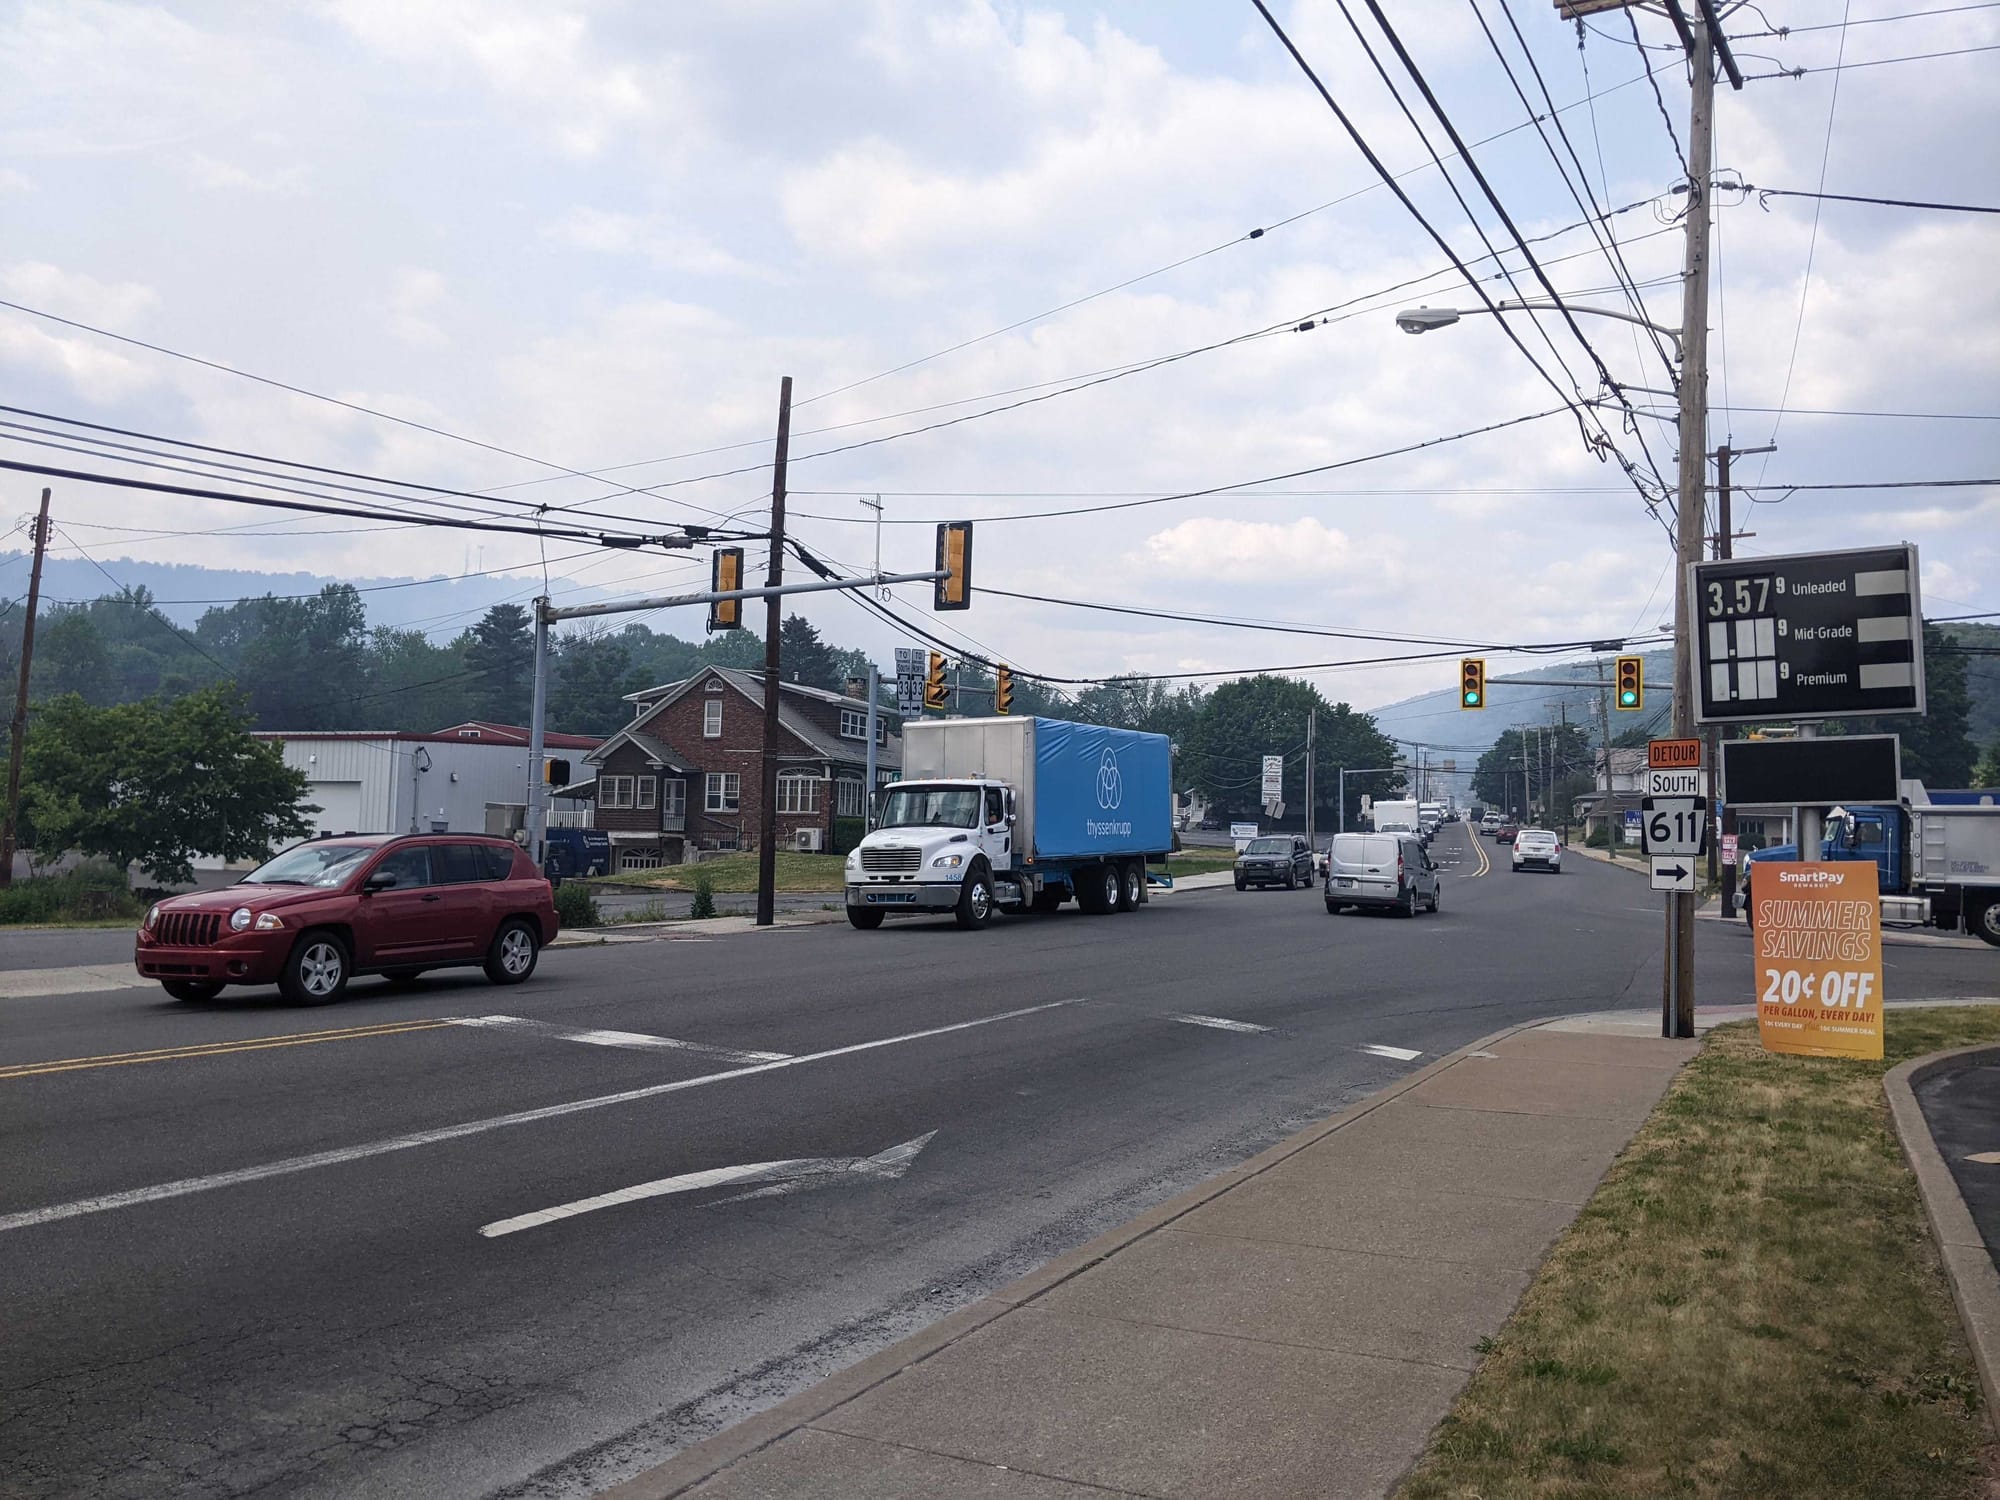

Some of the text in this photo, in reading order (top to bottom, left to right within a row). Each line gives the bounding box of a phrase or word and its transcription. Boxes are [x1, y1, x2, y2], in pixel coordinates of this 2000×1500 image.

[1708, 577, 1847, 616] 3.57 9 Unleaded
[1777, 619, 1853, 641] 9 Mid-Grade
[899, 651, 908, 659] TO
[1779, 662, 1848, 686] 9 Premium
[898, 681, 909, 695] 33
[912, 682, 923, 695] 33
[1653, 745, 1696, 762] DETOUR
[1652, 774, 1697, 793] SOUTH
[1087, 818, 1132, 839] thyssenkrupp
[1650, 812, 1696, 843] 611
[1779, 871, 1845, 885] SmartPay
[1759, 899, 1873, 930] SUMMER
[1762, 930, 1872, 961] SAVINGS
[1762, 969, 1874, 1009] 20¢ OFF
[1763, 1005, 1875, 1023] PER GALLON, EVERY DAY!
